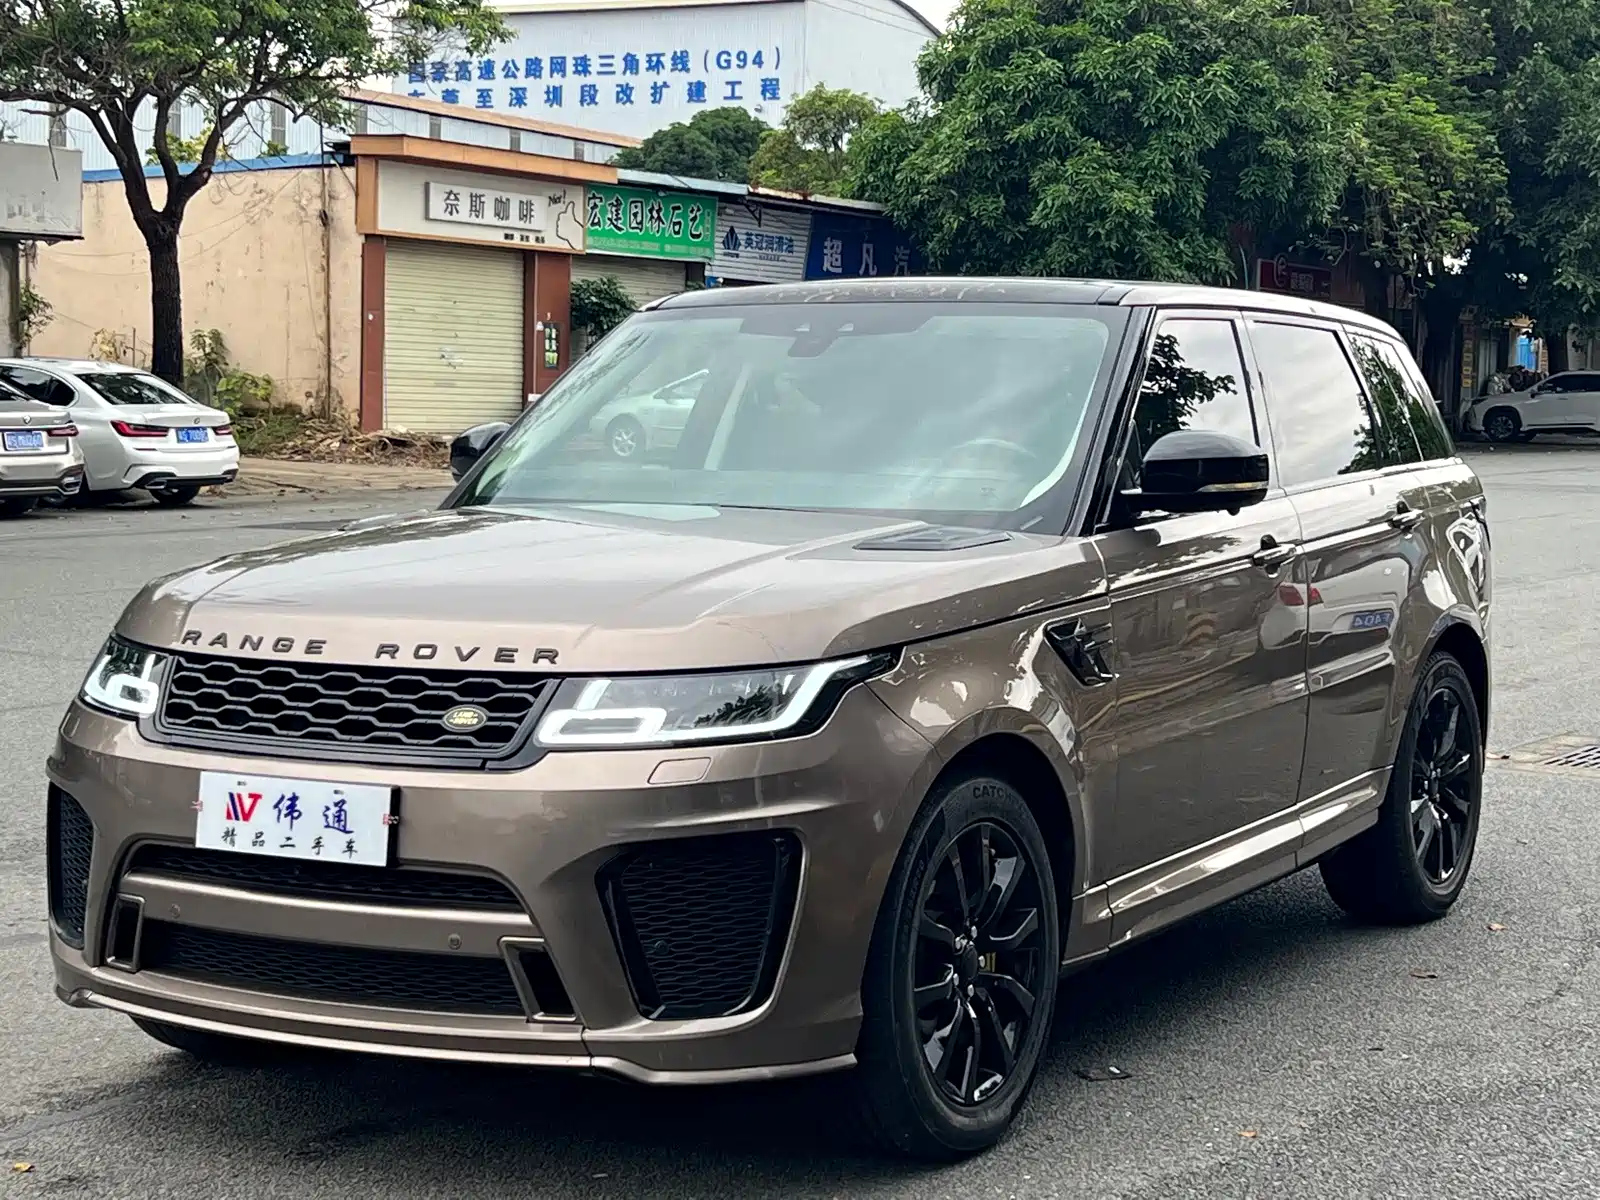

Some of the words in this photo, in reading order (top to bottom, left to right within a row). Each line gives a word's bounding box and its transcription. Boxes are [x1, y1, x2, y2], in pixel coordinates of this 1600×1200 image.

[443, 189, 535, 225] 奈斯咖啡
[586, 191, 703, 241] 宏建园林石艺
[181, 629, 328, 655] RANGE
[375, 643, 560, 665] ROVER
[273, 792, 354, 835] 伟通
[221, 826, 359, 858] 精品二手车
